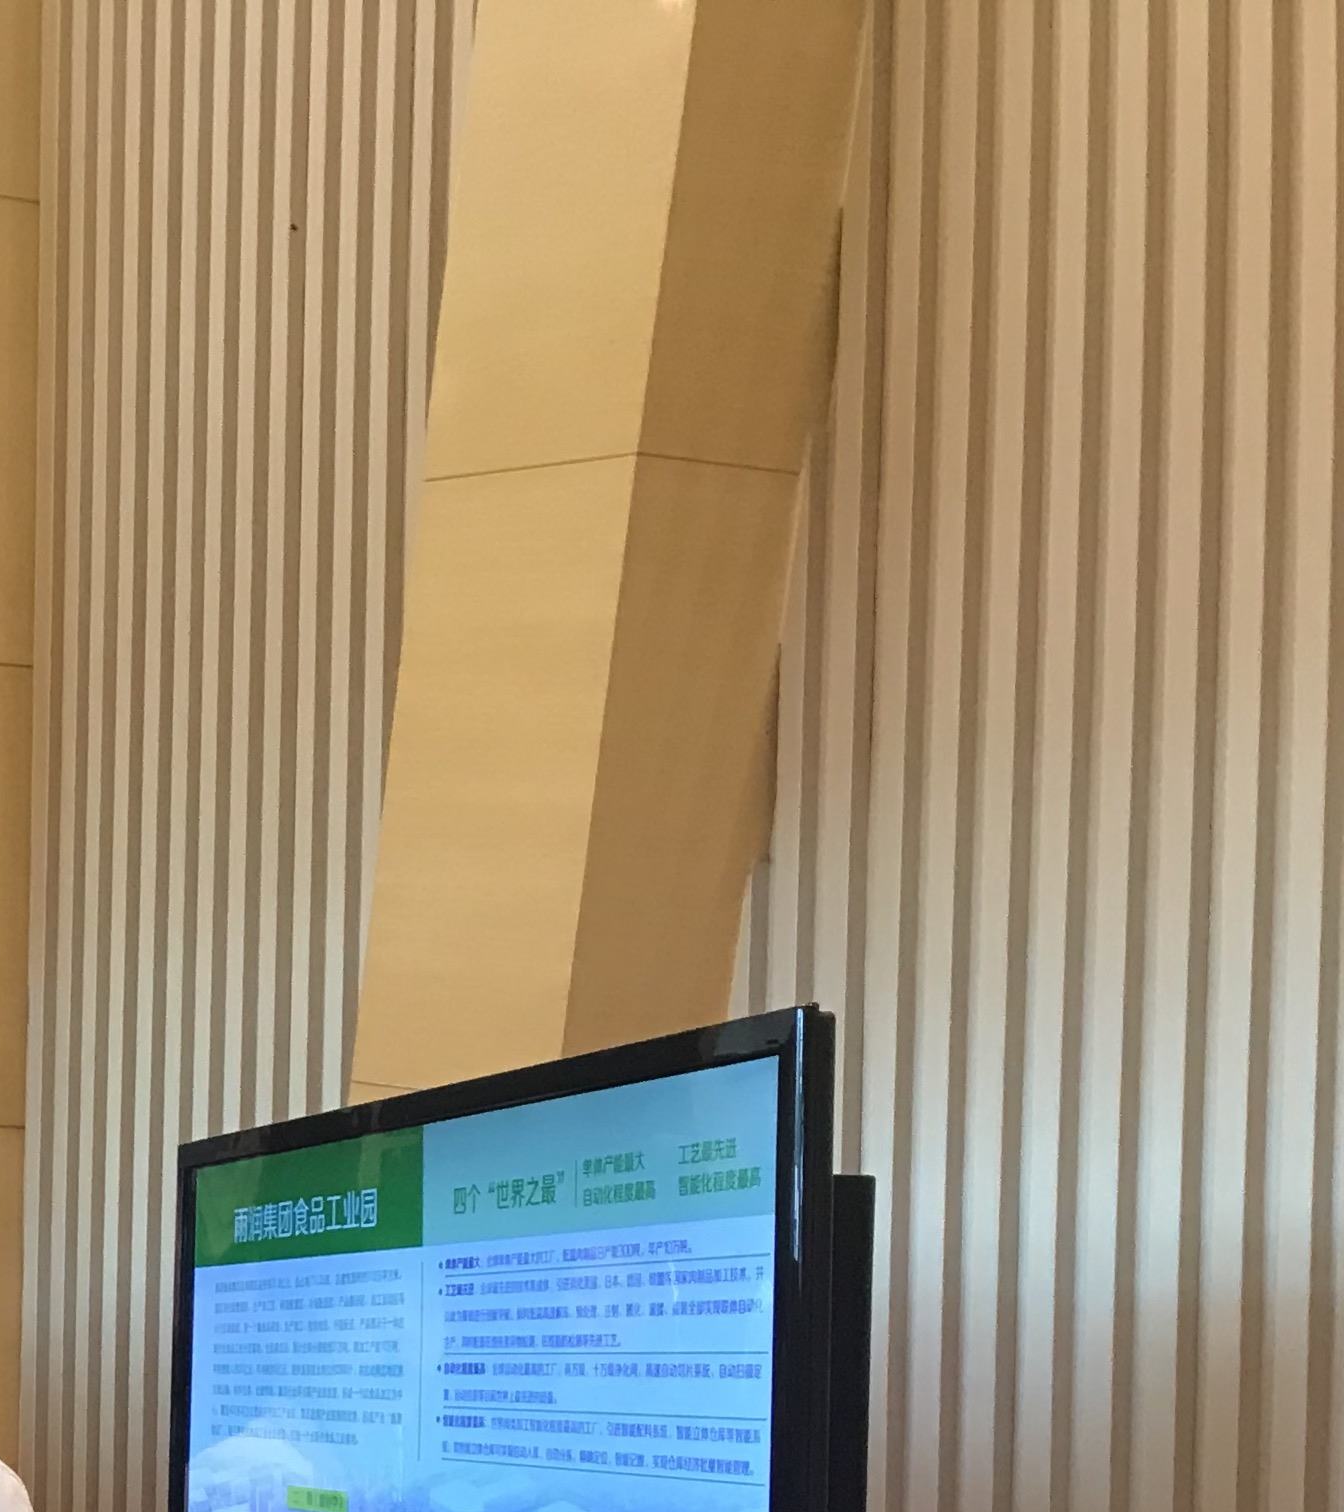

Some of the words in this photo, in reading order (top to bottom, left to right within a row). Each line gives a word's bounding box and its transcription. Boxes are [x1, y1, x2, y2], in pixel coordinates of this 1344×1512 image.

[234, 1188, 378, 1244] 雨润集团食品工业园
